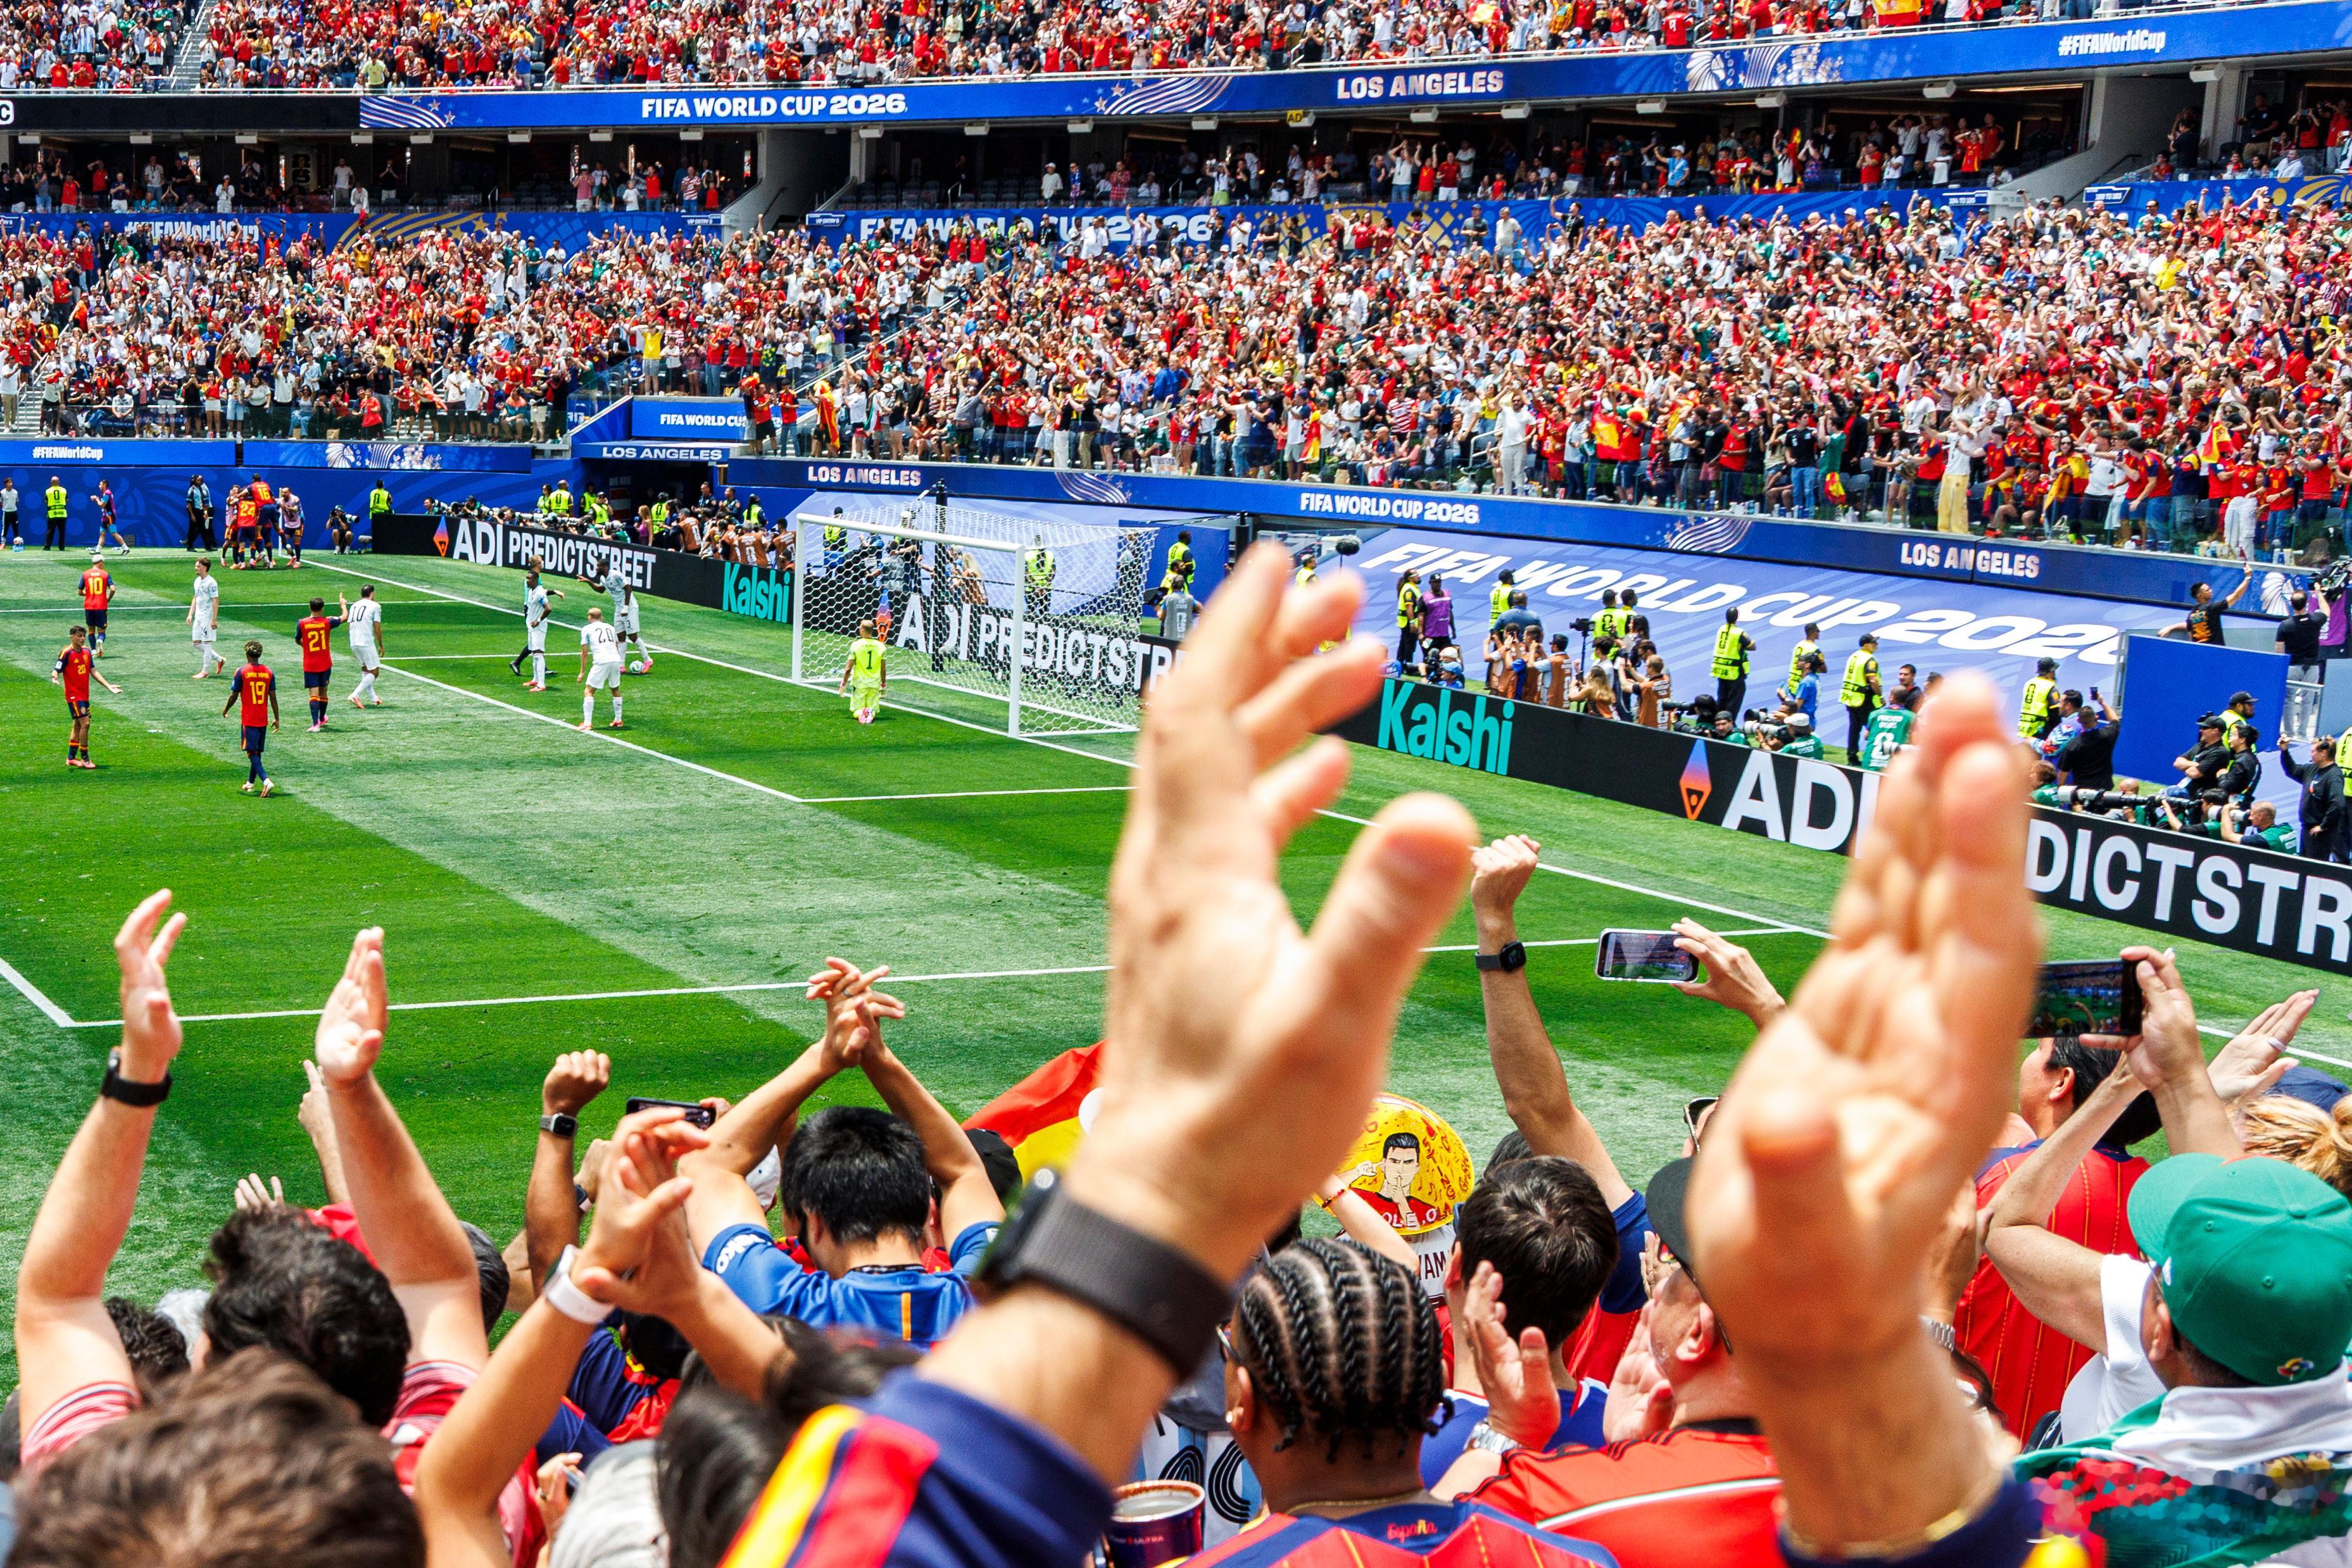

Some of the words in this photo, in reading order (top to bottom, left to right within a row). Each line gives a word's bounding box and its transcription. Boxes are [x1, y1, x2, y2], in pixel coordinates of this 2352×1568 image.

[2058, 30, 2165, 56] #FIFAWorldCup
[1337, 77, 1383, 99] LOS
[1390, 70, 1504, 97] ANGELES
[642, 97, 691, 118] FIFA
[693, 97, 777, 117] WORLD
[781, 95, 827, 115] CUP
[830, 92, 908, 115] 2026
[1287, 113, 1302, 123] AD
[126, 218, 259, 242] #IFAWorldCup
[660, 414, 683, 425] FIFA
[684, 415, 726, 426] WORLD
[33, 446, 103, 460] #FIFAWorldCup
[603, 447, 637, 458] LOS
[639, 448, 722, 460] ANGELES
[808, 465, 841, 482] LOS
[845, 468, 922, 487] ANGELES
[258, 487, 271, 500] 16
[240, 505, 256, 517] 24
[1300, 492, 1334, 511] FIFA
[1335, 495, 1391, 517] WORLD
[1392, 499, 1424, 520] CUP
[1424, 501, 1480, 524] 2026
[508, 530, 657, 589] PREDICTSTREET
[1901, 543, 1940, 567] LOS
[1944, 548, 2040, 579] ANGELES
[89, 577, 103, 595] 10
[722, 561, 791, 624] Kalshi
[1359, 543, 1512, 584] FIFA
[1508, 560, 1747, 613] WORLD
[1737, 591, 1901, 632] CUP
[351, 605, 367, 622] 10
[308, 630, 327, 652] 21
[595, 628, 613, 643] 20
[866, 651, 872, 669] 1
[978, 614, 1188, 693] PREDICTSTR
[77, 664, 87, 675] 20
[249, 681, 267, 705] 19
[1377, 678, 1516, 775] Kalshi
[2025, 818, 2352, 963] DICTSTR
